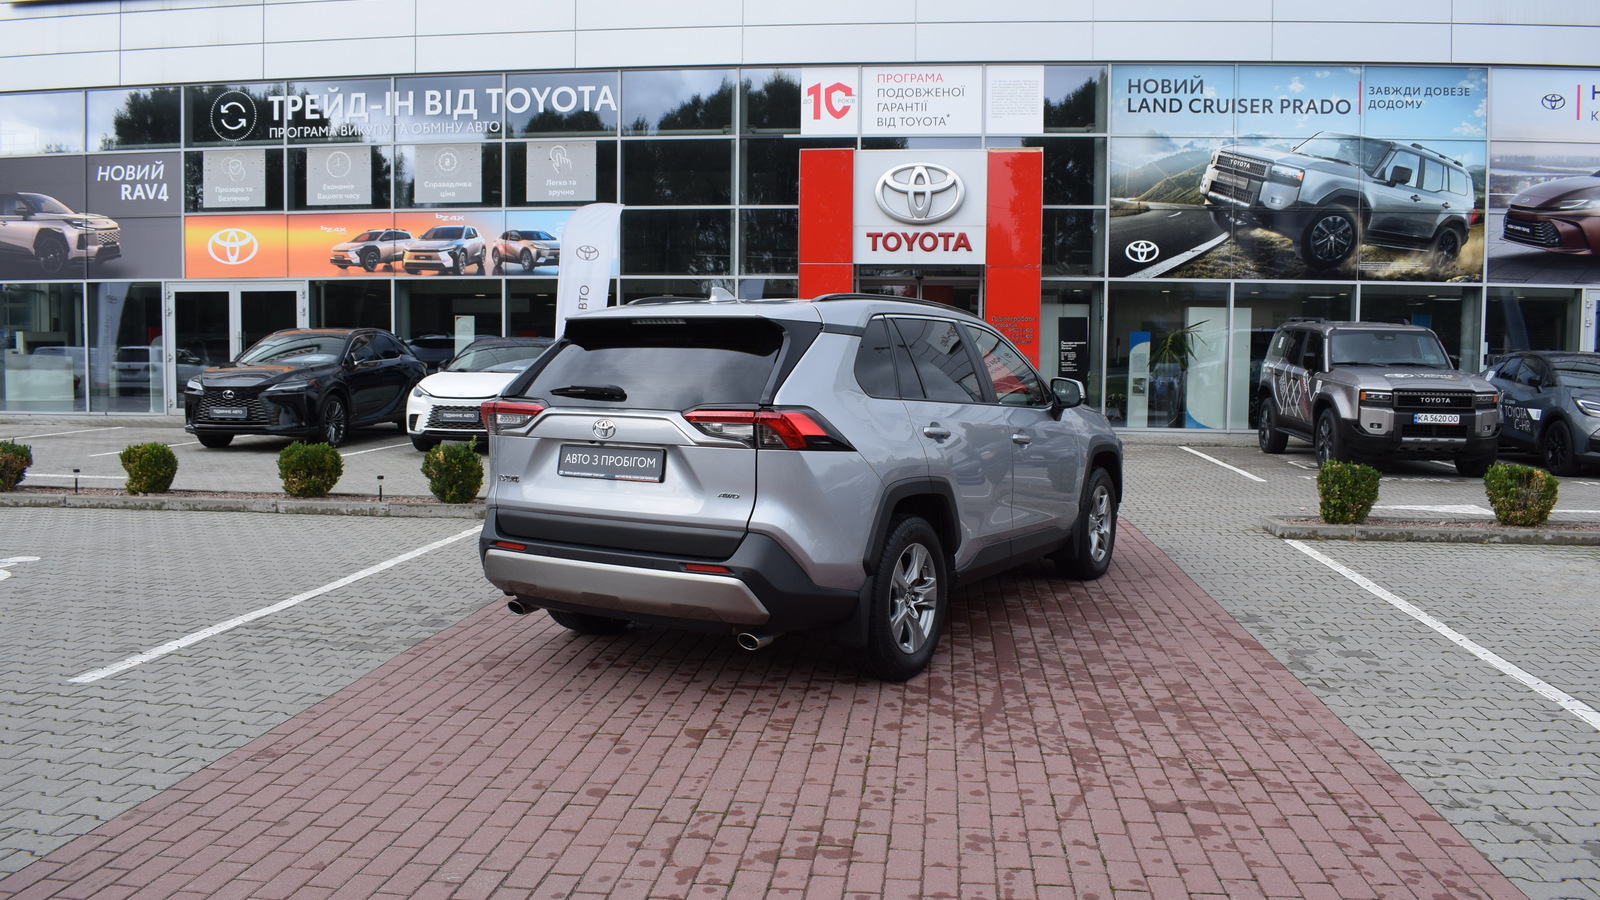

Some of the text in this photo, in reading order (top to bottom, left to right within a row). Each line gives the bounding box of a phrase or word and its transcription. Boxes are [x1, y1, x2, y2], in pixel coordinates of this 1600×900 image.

[877, 73, 944, 84] ПРОГРАМА
[1127, 74, 1204, 95] НОВИЙ
[876, 85, 966, 100] ПОДОВЖЕНОЇ
[1368, 86, 1471, 98] ЗАВЖДИ ДОВЕЗЕ
[268, 85, 618, 122] ТРЕЙД-ІН ВІД TOYOTA
[877, 100, 928, 113] ГАРАНТІЇ
[1127, 97, 1352, 115] LAND CRUISER PRADO
[1368, 99, 1423, 110] ДОДОМУ
[877, 116, 896, 128] ВІД
[269, 120, 500, 139] ПРОГРАМА ВИКУПУ ТА ОБМІНУ АВТО
[96, 160, 165, 182] НОВИЙ
[1230, 159, 1250, 169] TOYOTA
[424, 181, 472, 189] Справедлива
[120, 183, 169, 202] RAV4
[548, 189, 575, 197] зручно
[866, 232, 973, 252] TOYOTA
[578, 285, 590, 310] ВТО
[1504, 405, 1528, 419] TOYOTA
[1514, 418, 1531, 431] C-HR
[564, 453, 590, 465] АВТО
[600, 455, 656, 468] ПРОБІГОМ
